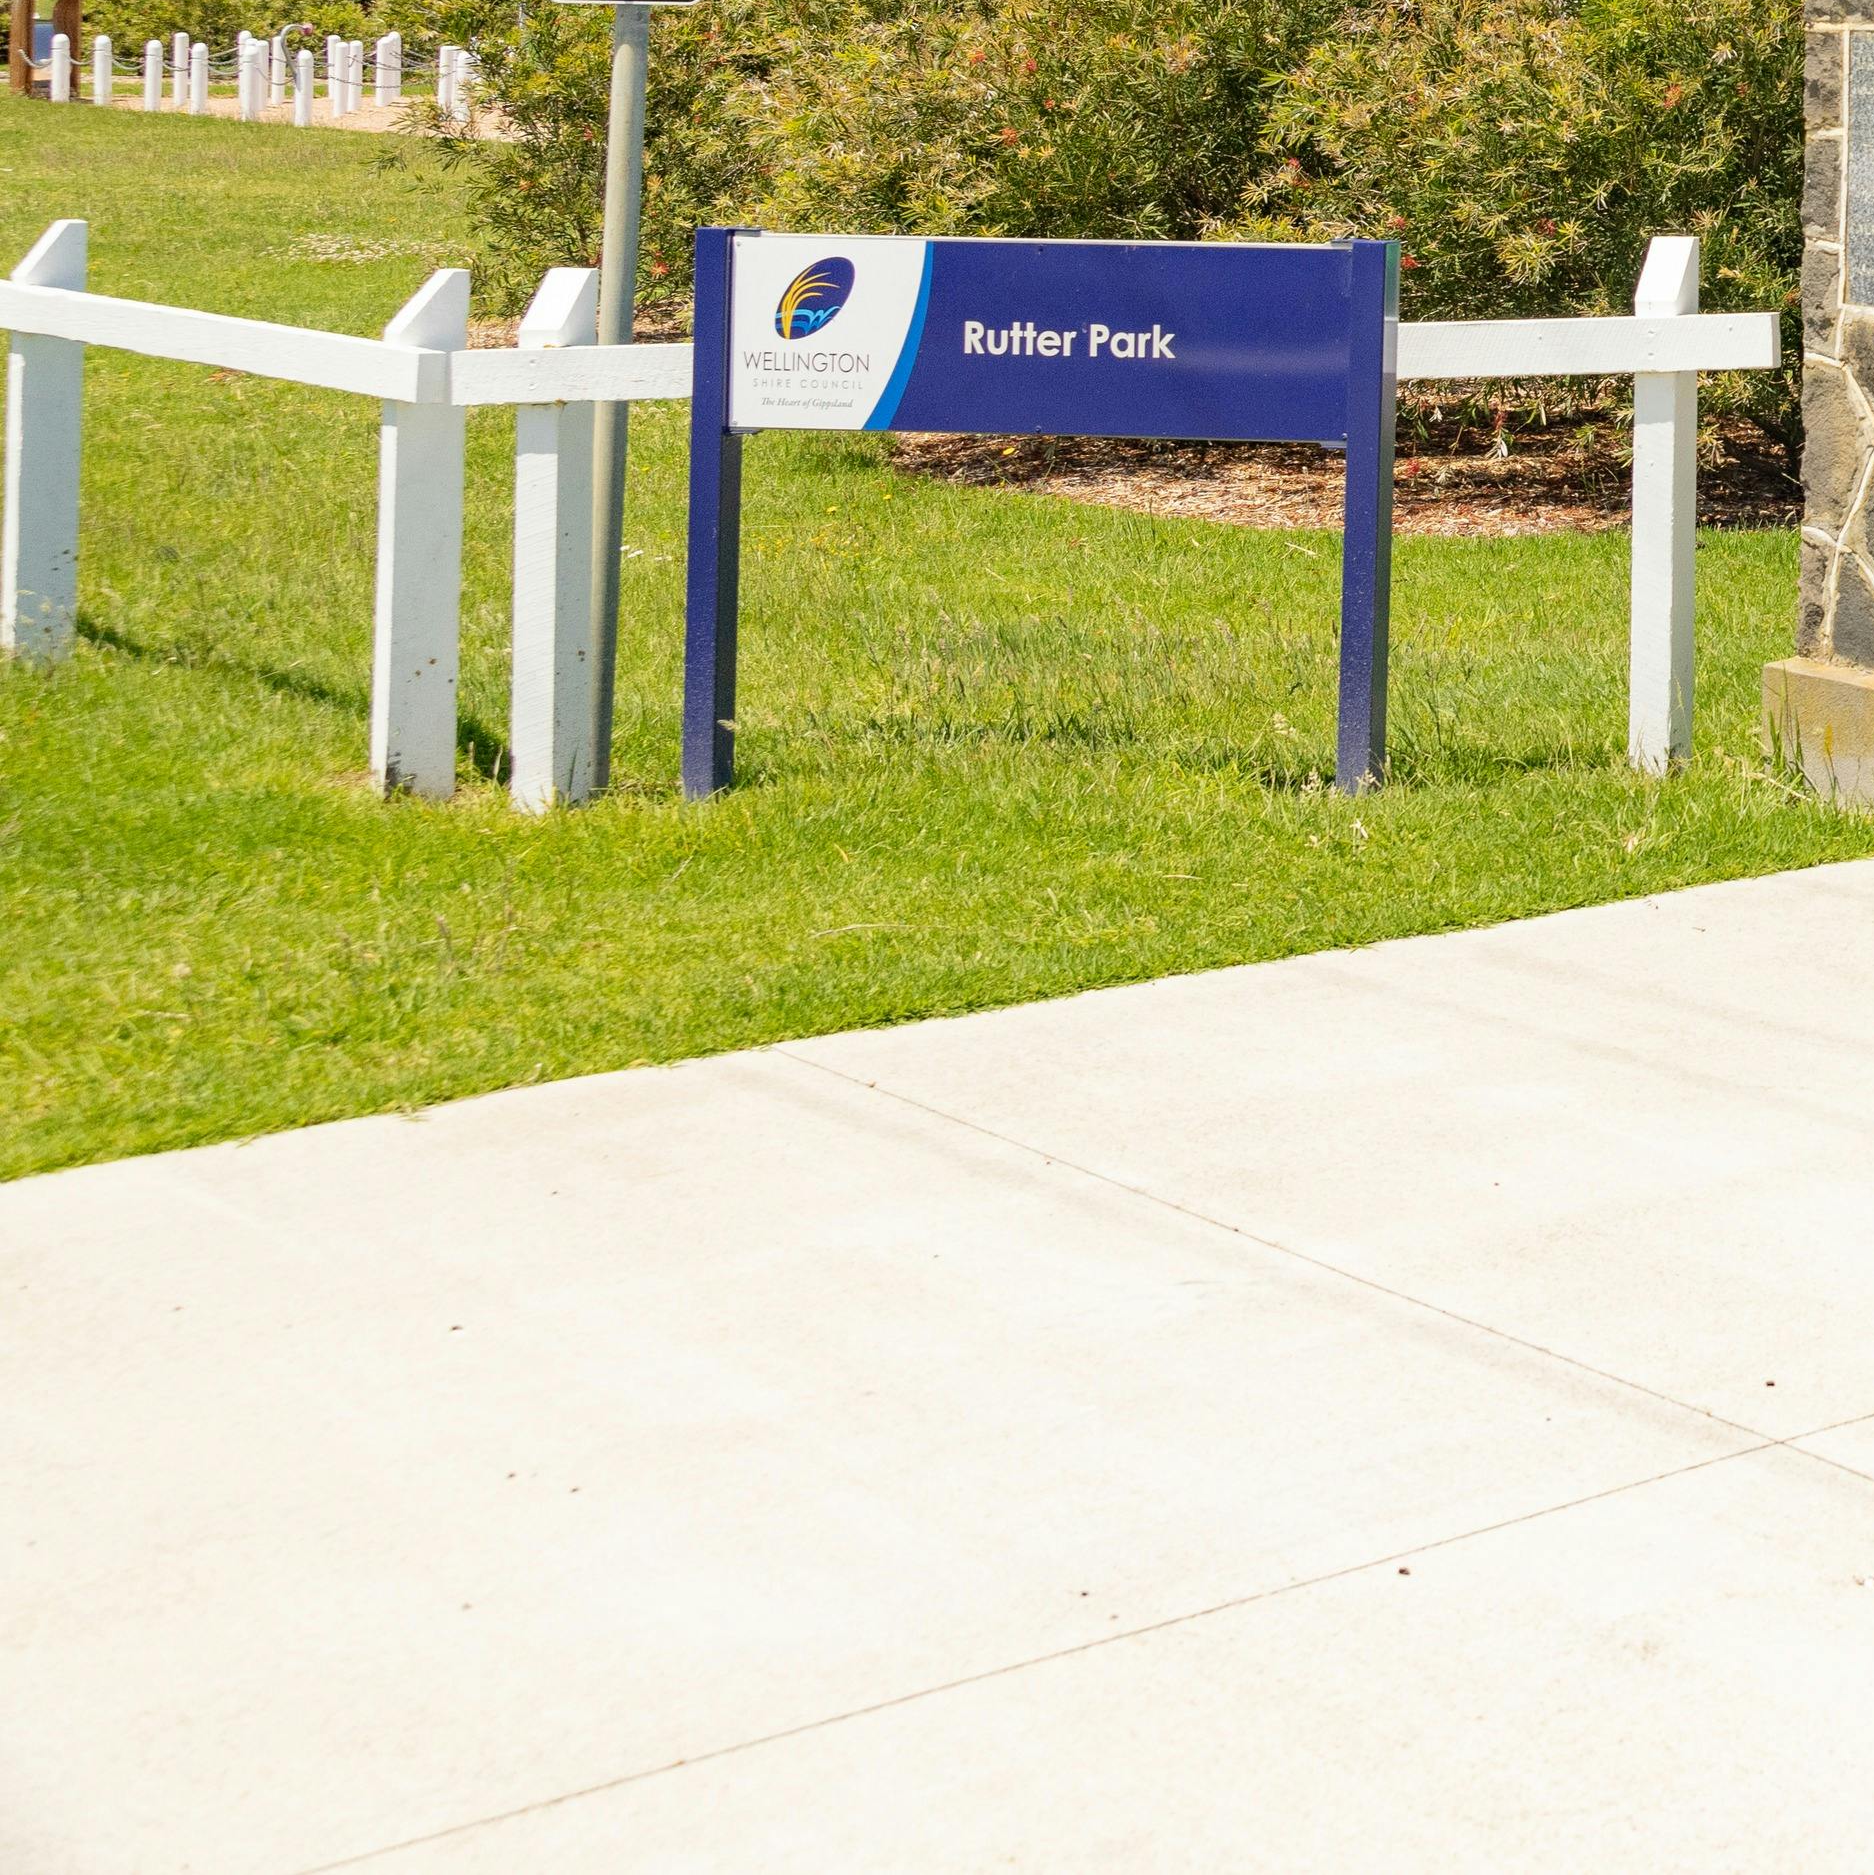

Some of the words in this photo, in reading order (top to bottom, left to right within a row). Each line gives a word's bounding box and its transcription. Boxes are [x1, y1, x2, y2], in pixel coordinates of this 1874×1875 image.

[964, 321, 1077, 357] Rutter
[1089, 324, 1176, 358] Park
[743, 351, 870, 373] WELLINGTON
[753, 377, 791, 389] SHIRE
[800, 379, 863, 390] COUNCIL
[761, 397, 774, 407] The
[778, 398, 801, 407] Heart
[802, 398, 812, 409] of
[812, 399, 854, 410] Gippsland
